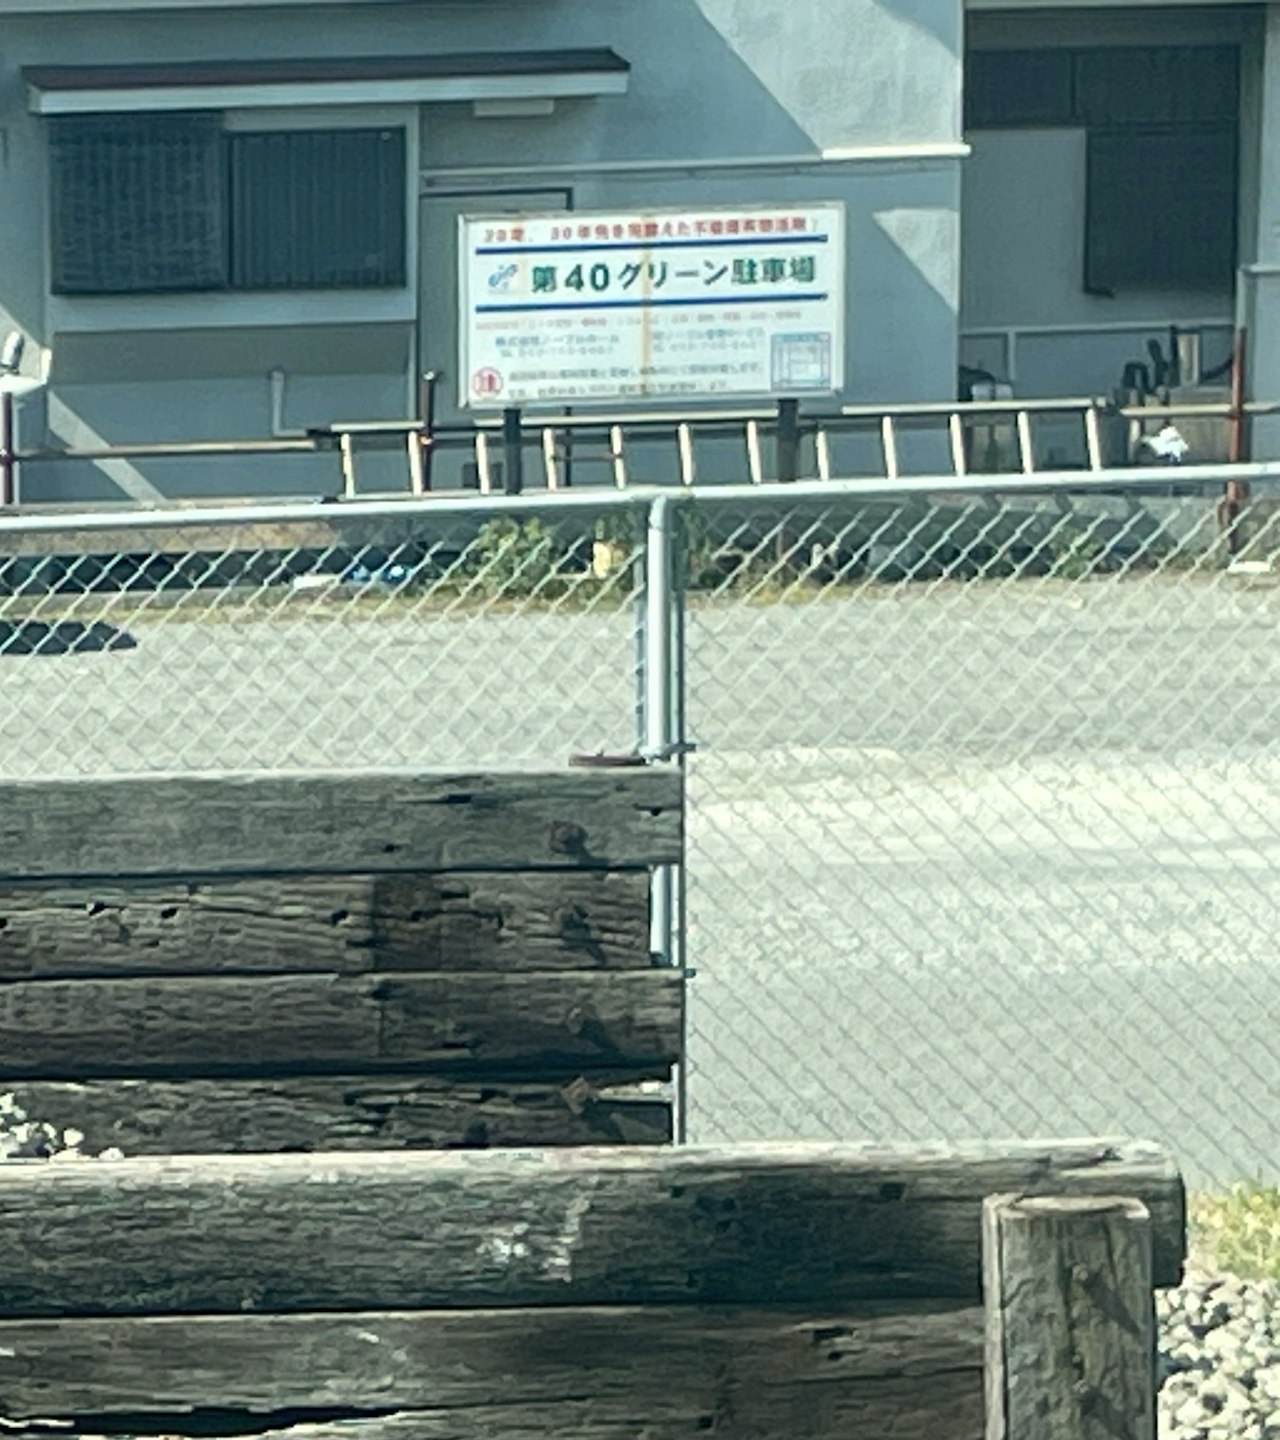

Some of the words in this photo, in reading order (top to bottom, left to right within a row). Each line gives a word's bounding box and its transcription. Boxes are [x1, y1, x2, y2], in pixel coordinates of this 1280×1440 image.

[532, 256, 815, 293] 第40グリーン駐車場
